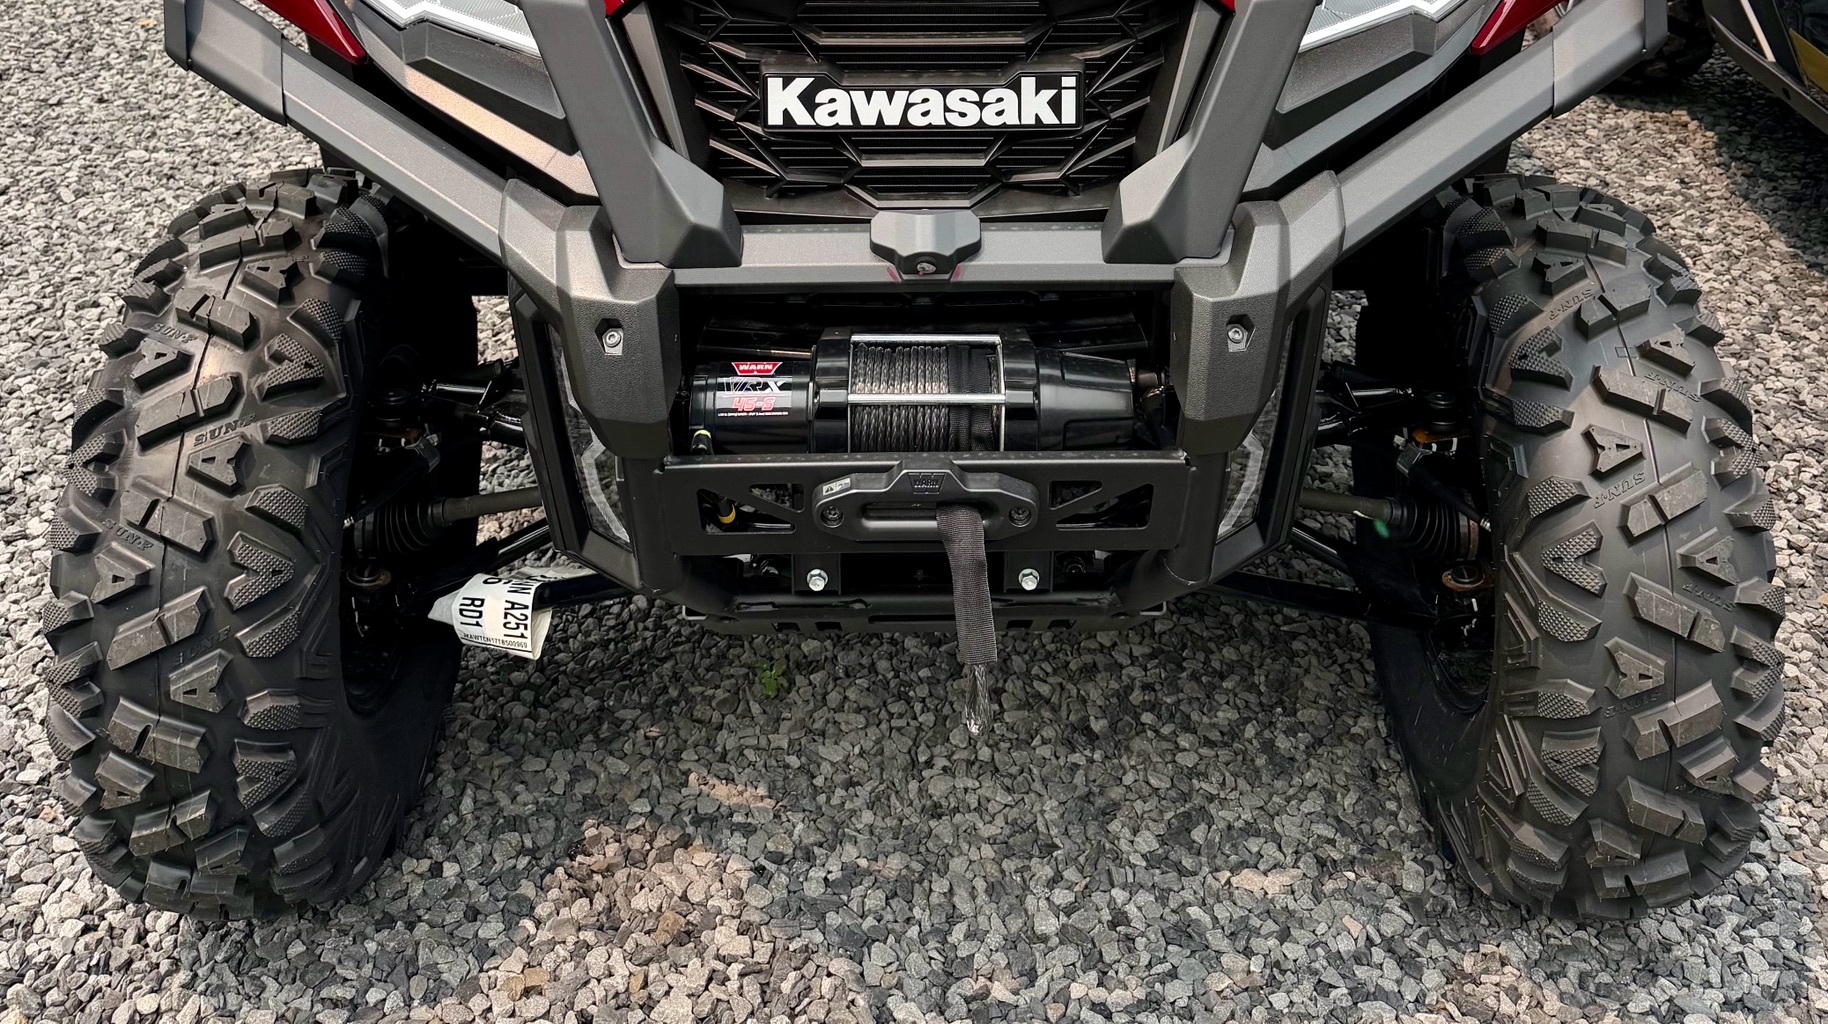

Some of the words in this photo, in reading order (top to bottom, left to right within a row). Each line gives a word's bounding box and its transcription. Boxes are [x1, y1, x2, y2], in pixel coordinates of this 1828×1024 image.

[767, 76, 1077, 127] Kawasaki
[723, 376, 787, 395] VRX
[458, 596, 486, 628] RD1
[502, 599, 530, 639] A251
